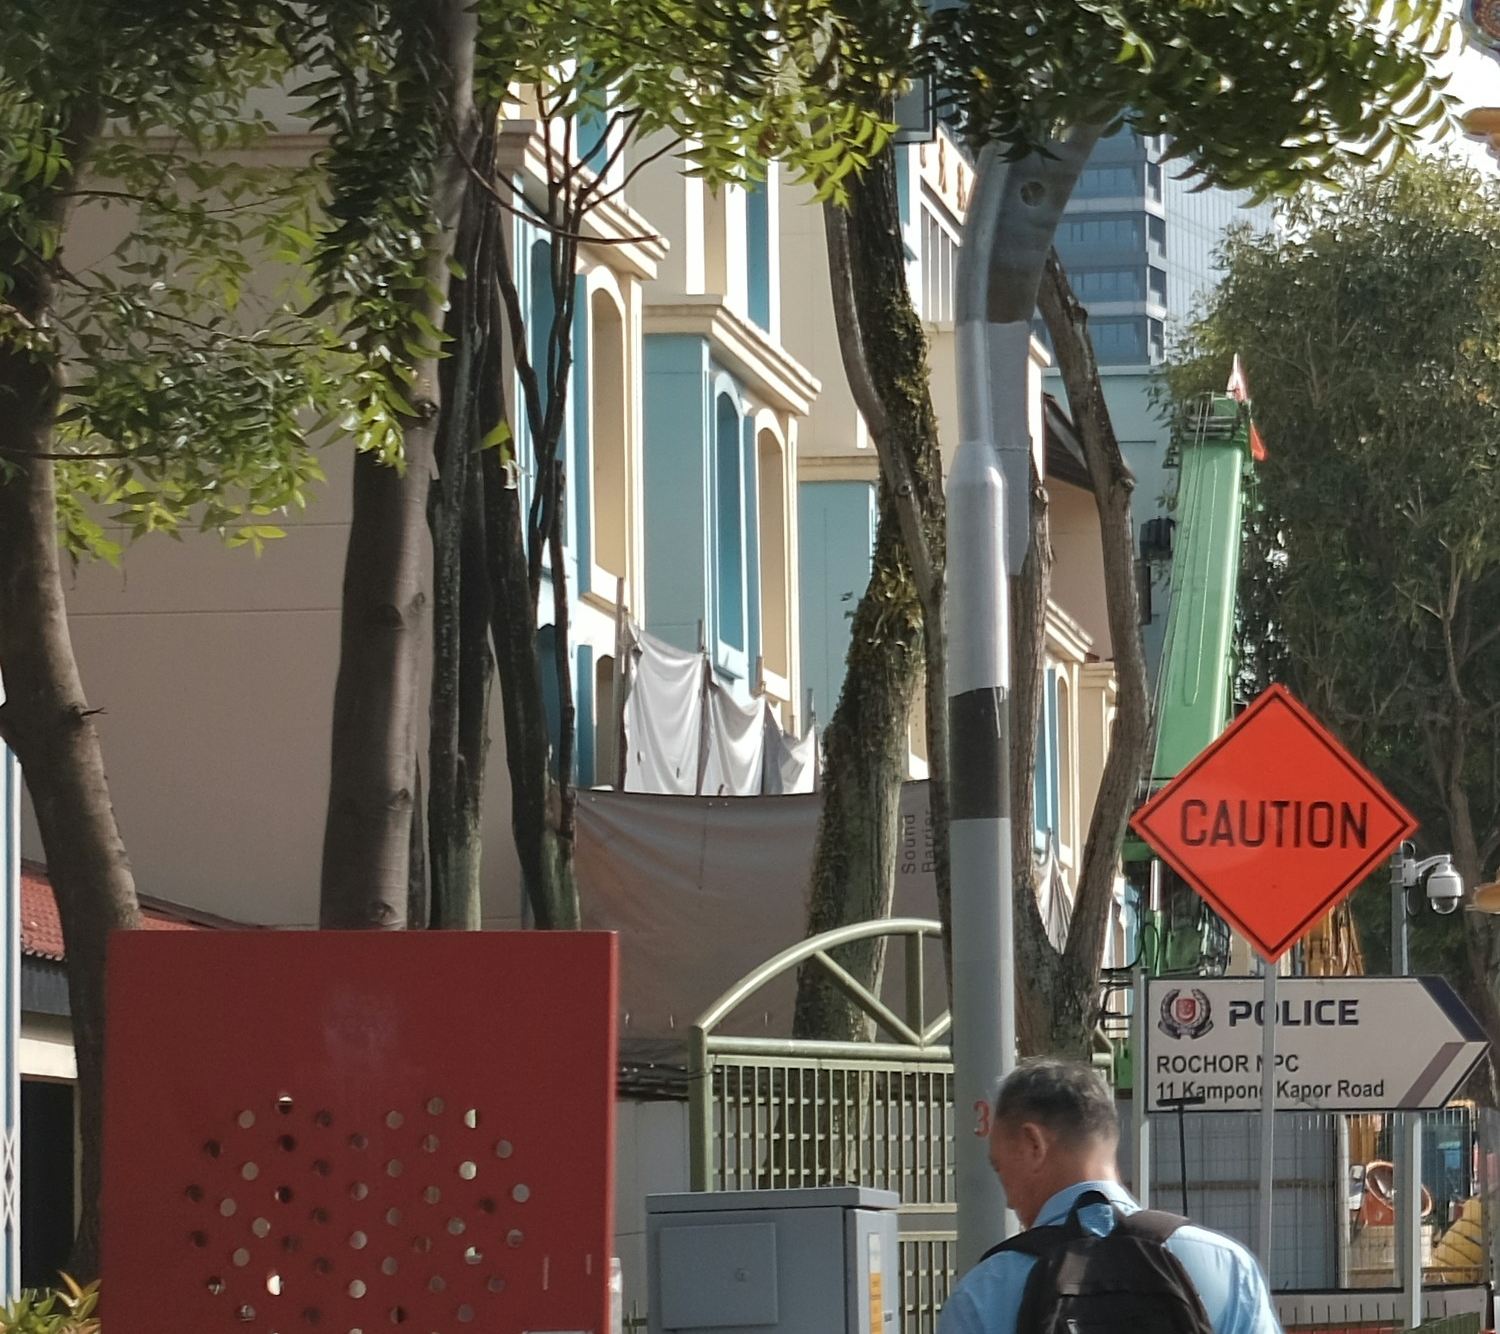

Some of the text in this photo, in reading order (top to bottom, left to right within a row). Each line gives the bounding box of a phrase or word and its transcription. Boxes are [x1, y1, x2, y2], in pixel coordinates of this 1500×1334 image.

[1180, 798, 1368, 849] CAUTION
[902, 814, 916, 875] Sound
[1228, 1000, 1359, 1027] POLICE
[1156, 1054, 1249, 1074] ROCHOR
[1182, 1081, 1264, 1103] Kampon
[1277, 1080, 1332, 1103] Kapor
[1337, 1079, 1384, 1098] Road
